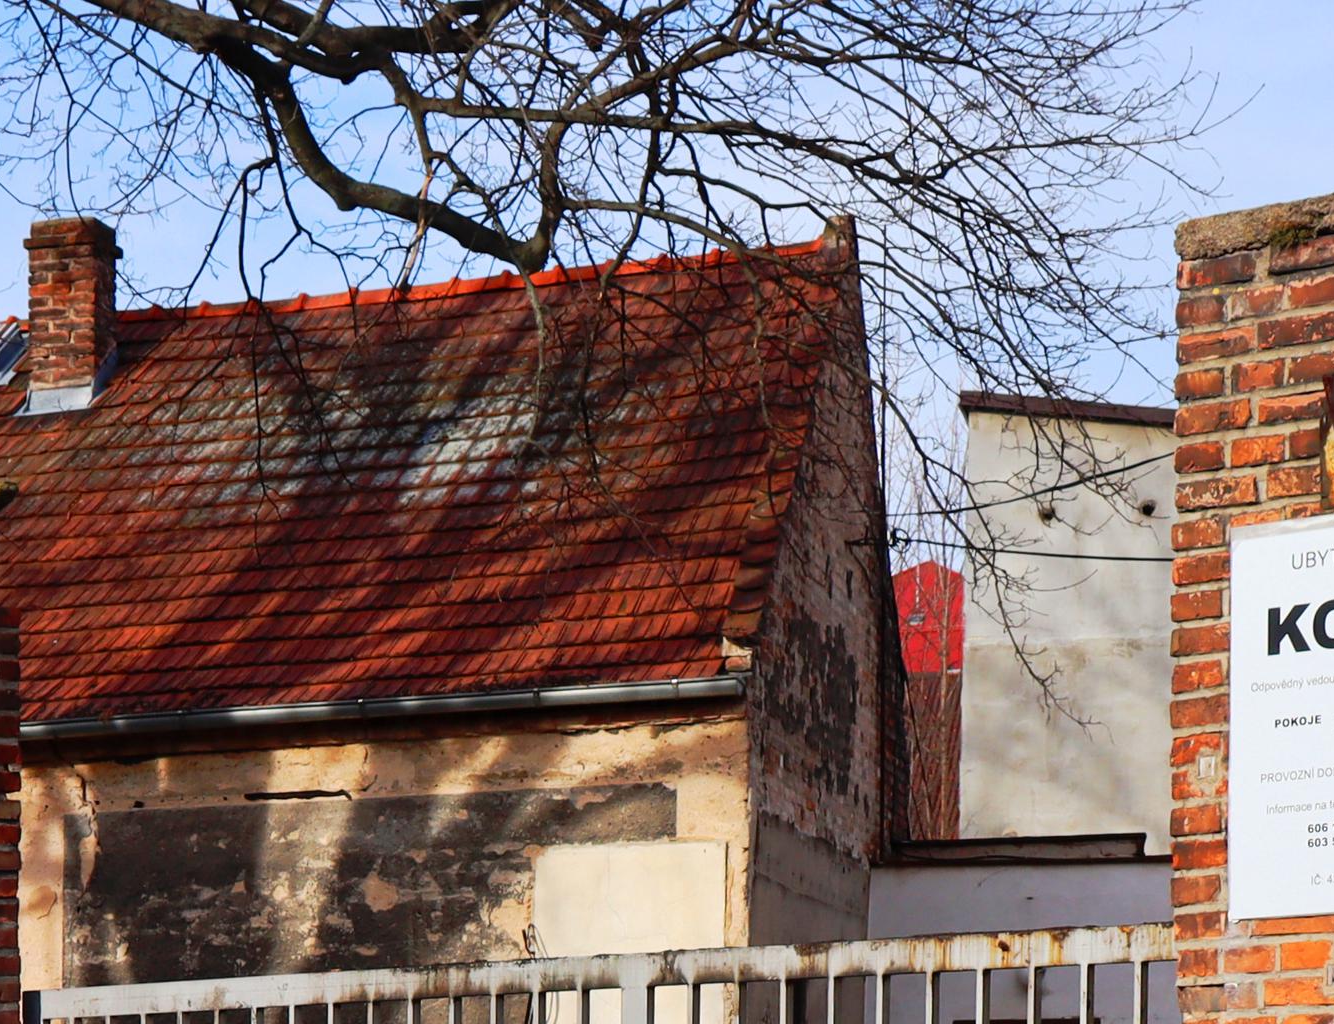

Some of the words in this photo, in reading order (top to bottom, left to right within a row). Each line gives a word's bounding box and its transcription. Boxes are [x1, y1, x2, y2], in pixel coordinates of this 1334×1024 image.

[1251, 677, 1304, 693] Odpovědný
[1274, 714, 1322, 728] POKOJE
[1260, 767, 1315, 784] PROVOZNÍ
[1266, 802, 1313, 816] Informace
[1315, 801, 1327, 811] na
[1307, 823, 1328, 834] 606
[1307, 837, 1328, 848] 603
